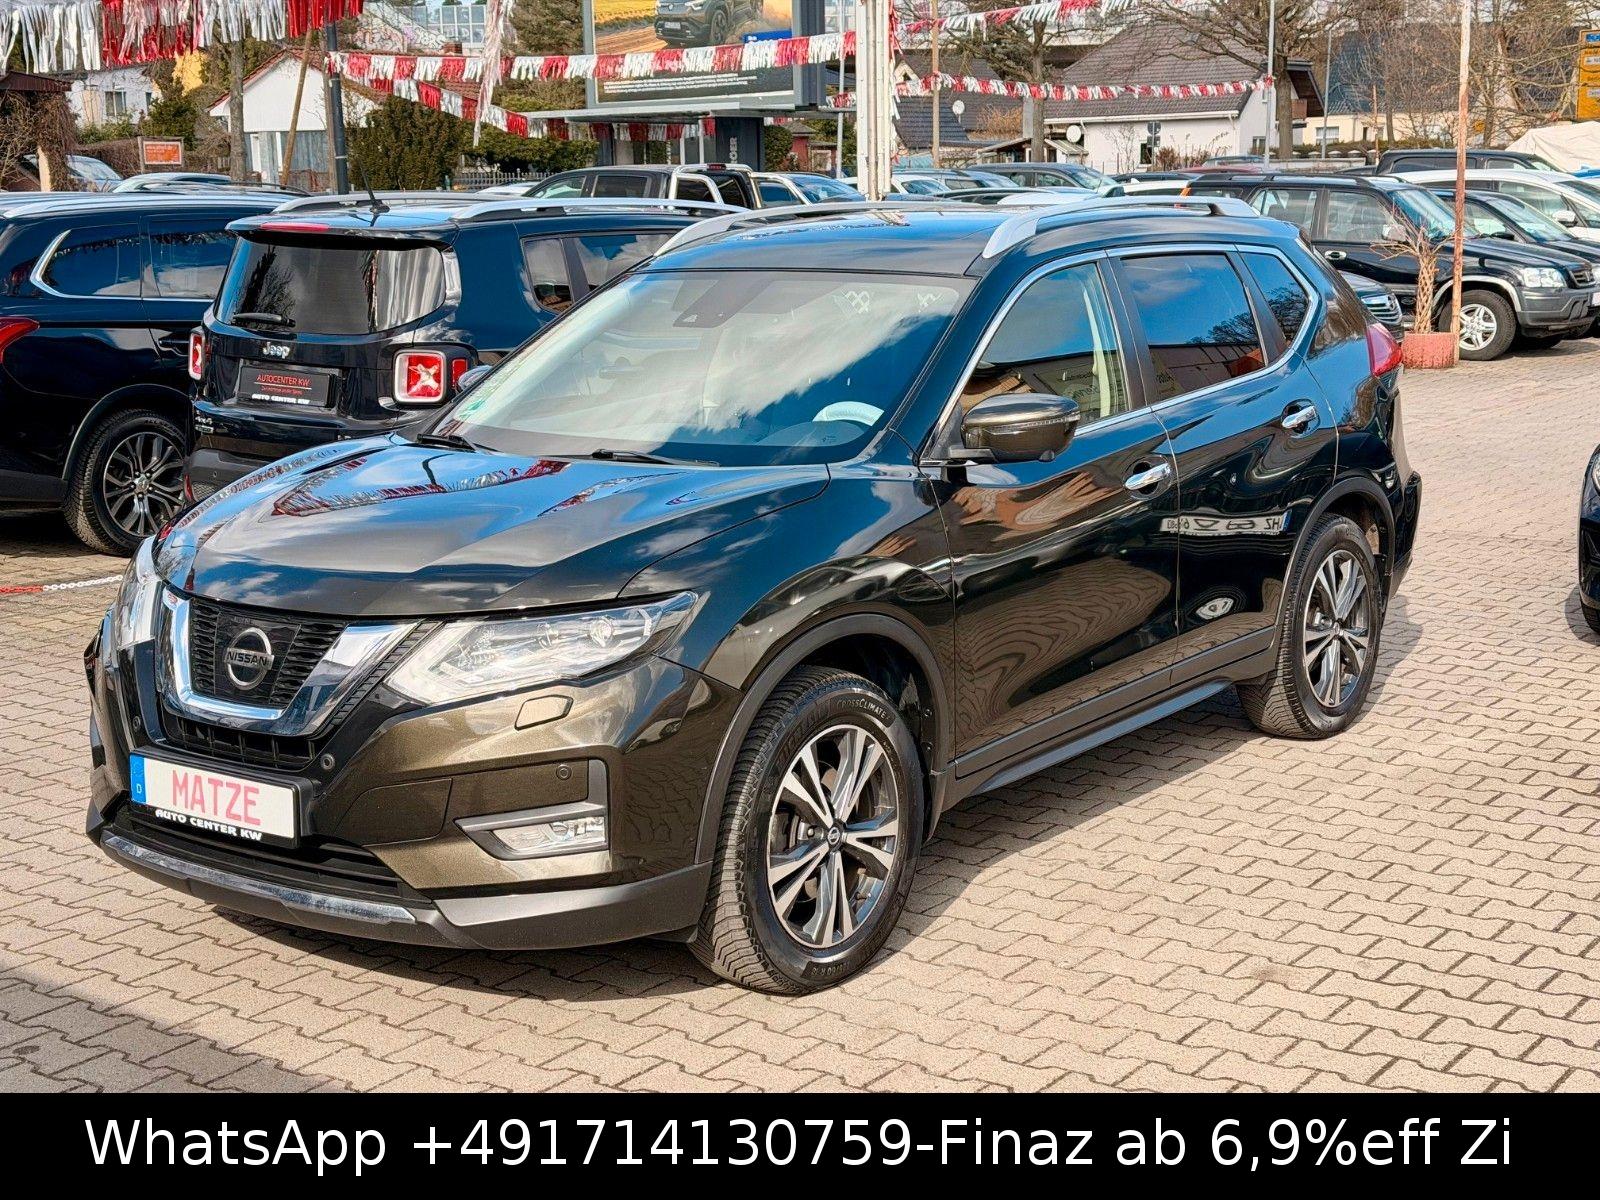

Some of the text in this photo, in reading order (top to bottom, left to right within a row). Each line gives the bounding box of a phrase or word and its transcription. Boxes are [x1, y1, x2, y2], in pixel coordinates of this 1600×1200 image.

[263, 342, 290, 359] Jeep
[257, 374, 310, 386] AUTOCENTER KW
[227, 651, 268, 666] NISSAN
[136, 783, 142, 794] D
[172, 769, 261, 826] MATZE
[155, 809, 263, 841] AUTO CENTER KW
